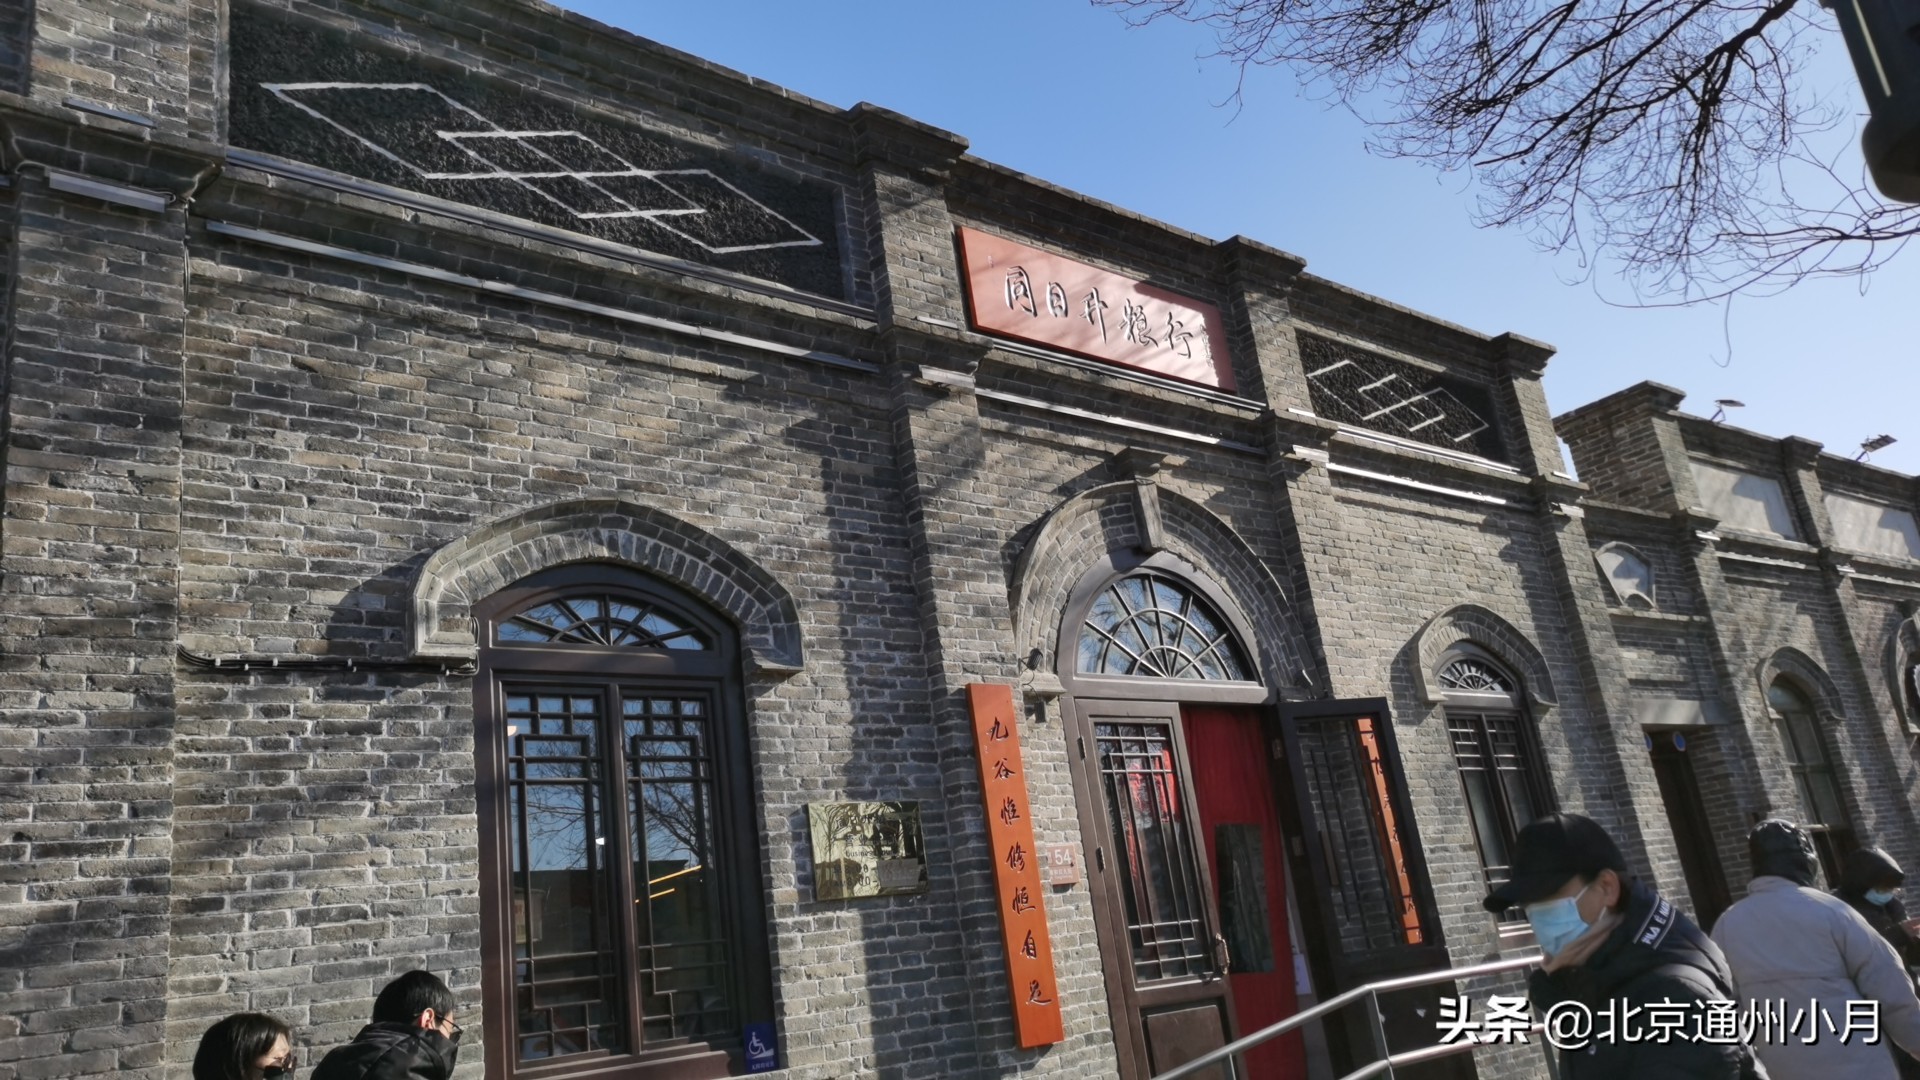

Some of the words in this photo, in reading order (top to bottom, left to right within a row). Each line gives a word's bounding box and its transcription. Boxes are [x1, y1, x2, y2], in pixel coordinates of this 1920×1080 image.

[1004, 265, 1194, 359] 同日升粮行
[1054, 849, 1072, 865] 54
